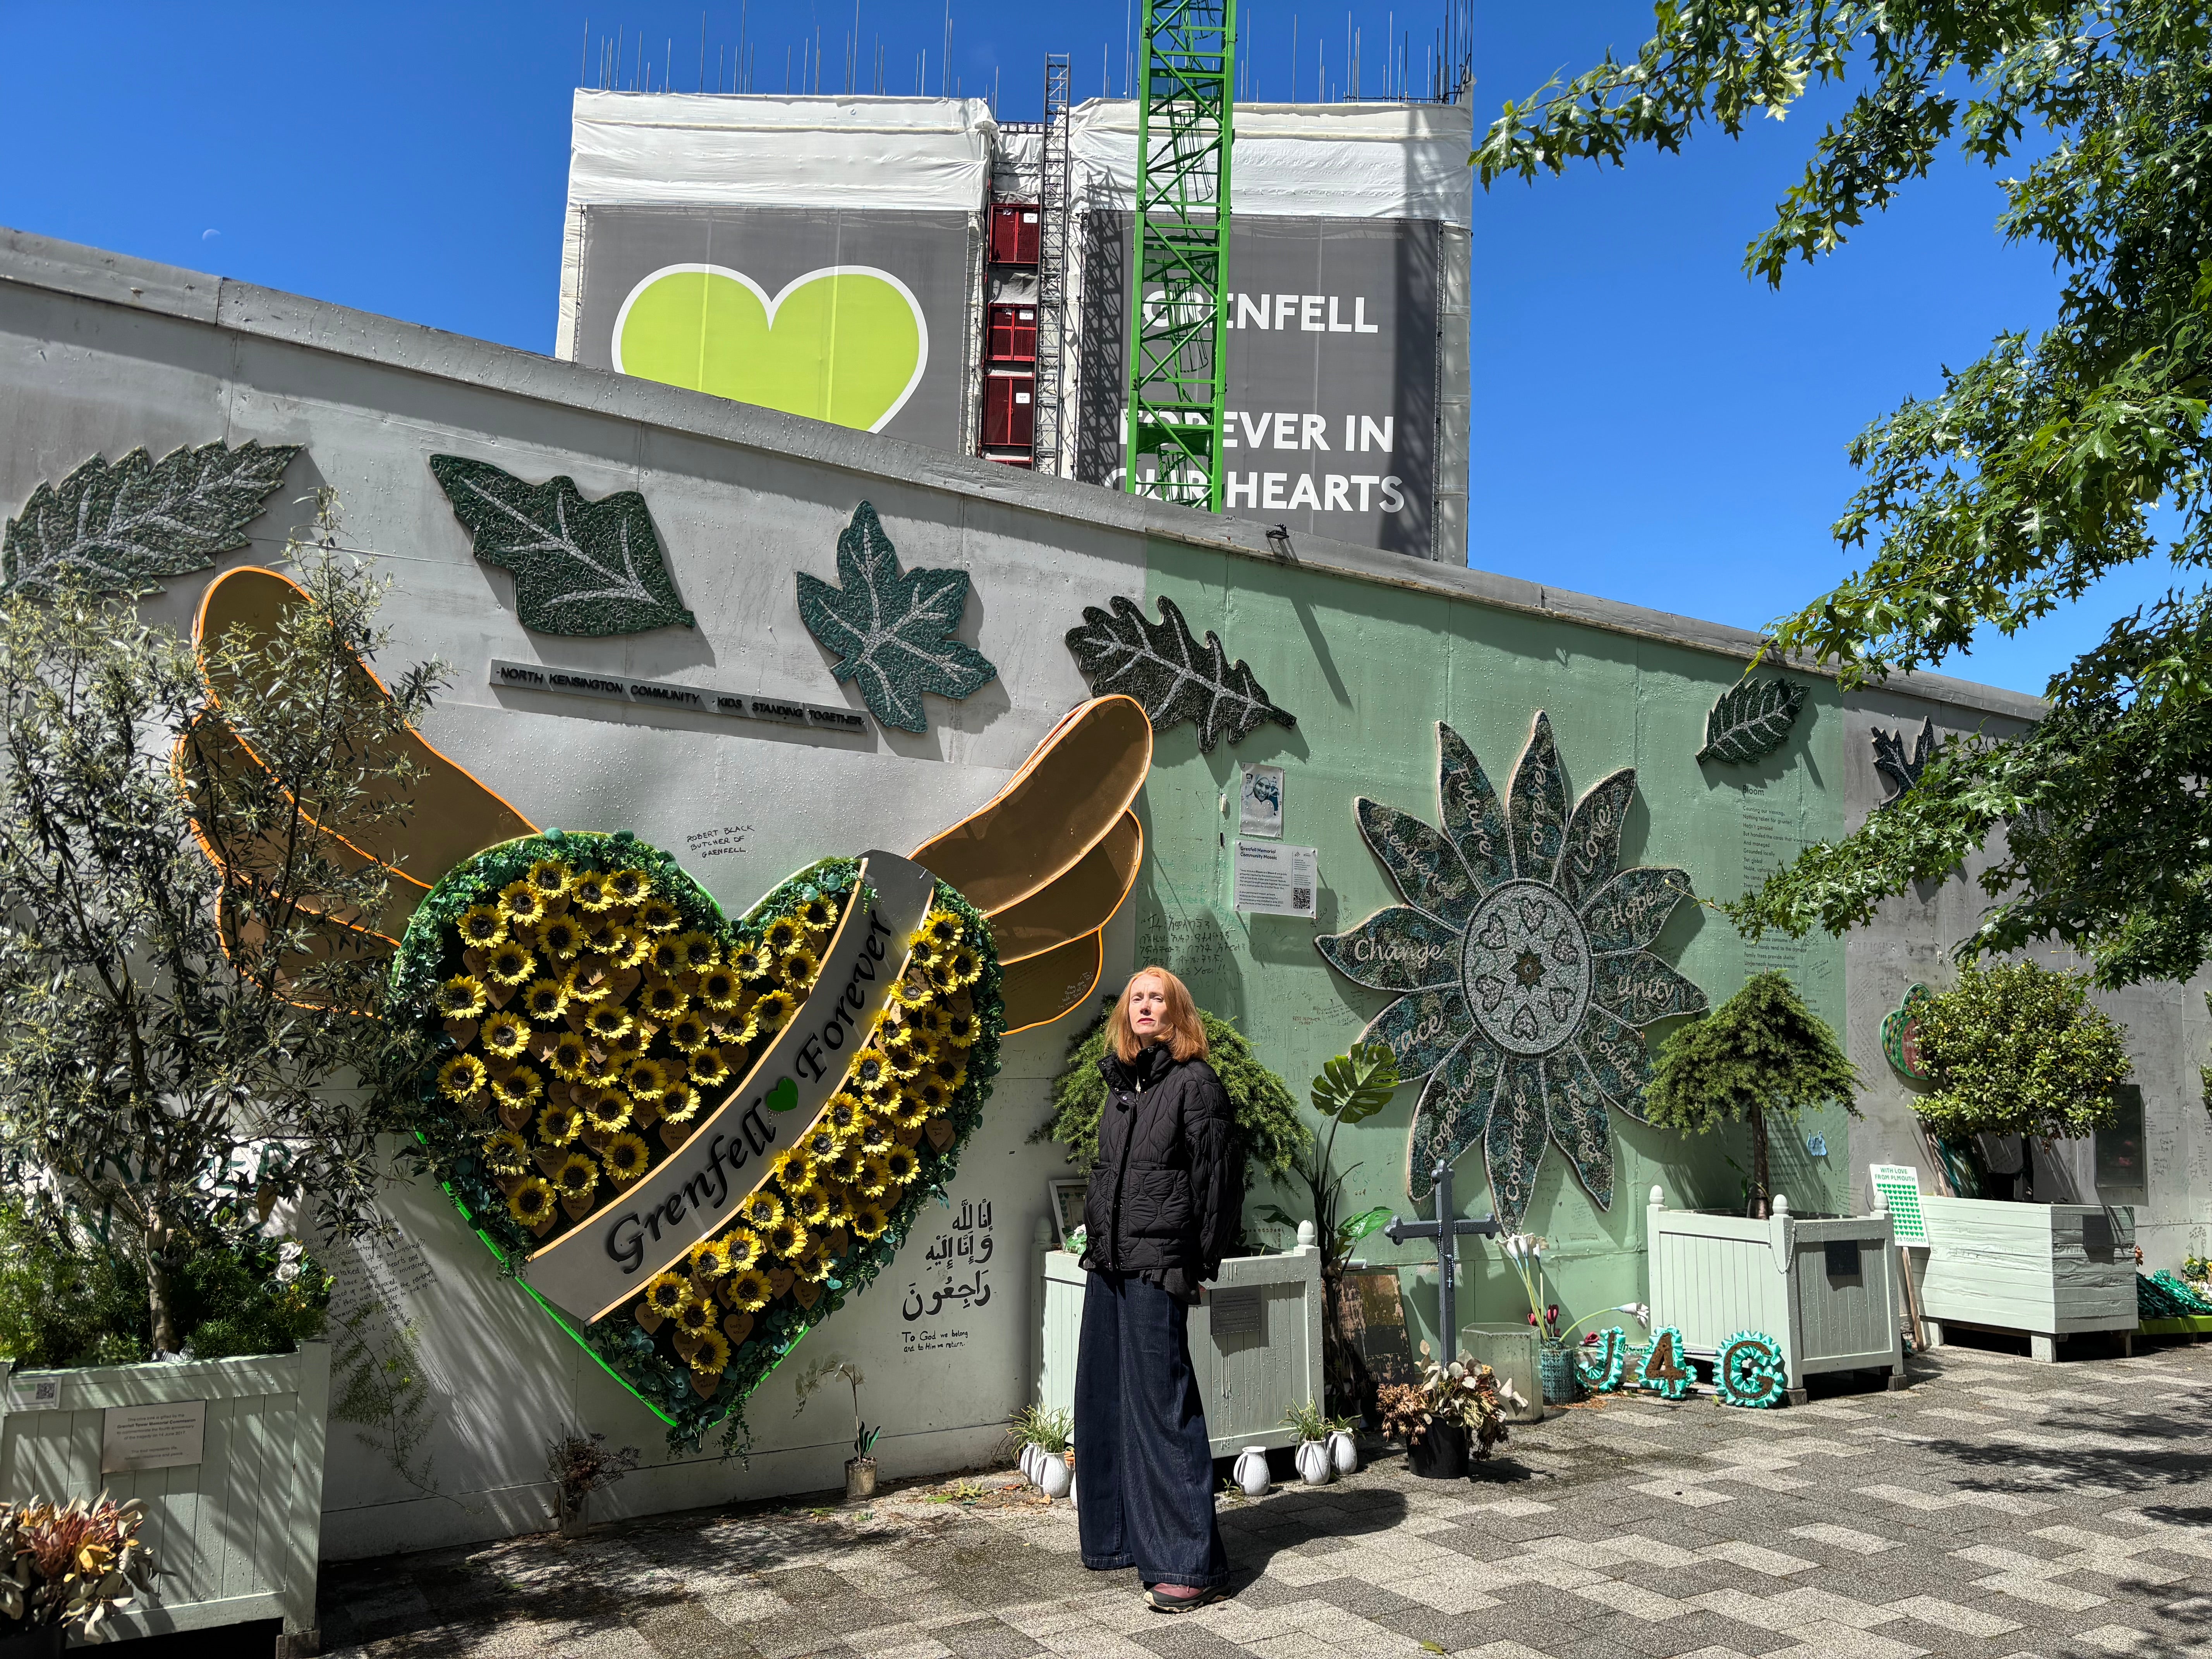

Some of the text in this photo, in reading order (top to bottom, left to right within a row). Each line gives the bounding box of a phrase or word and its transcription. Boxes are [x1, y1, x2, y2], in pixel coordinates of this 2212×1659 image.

[1346, 415, 1394, 452] IN
[1227, 471, 1405, 513] HEARTS
[501, 668, 862, 725] NORTH KENSINGTON COMMUNITY KIDS STANDING TOGETHER
[1743, 785, 1764, 795] Bloom
[1449, 762, 1494, 857] Future
[1527, 754, 1549, 861] Forever
[687, 825, 755, 842] ROBERT BLACK
[690, 838, 730, 851] BUTCHER
[702, 847, 746, 858] GRENFELL
[1611, 891, 1658, 929] Hope
[1354, 939, 1444, 970] Change
[795, 909, 892, 1083] Forever
[1617, 975, 1675, 1006] Unity
[1386, 1015, 1443, 1052] race
[1505, 1088, 1530, 1201] Courage
[606, 1097, 777, 1274] Grenfell
[304, 1233, 326, 1245] could
[386, 1256, 405, 1267] hearts
[409, 1254, 419, 1262] and
[328, 1302, 340, 1311] will
[343, 1298, 357, 1307] they
[376, 1286, 398, 1298] between
[330, 1290, 347, 1301] anged
[410, 1286, 420, 1295] pick
[356, 1324, 377, 1336] have
[902, 1331, 915, 1343] To
[919, 1331, 936, 1341] God
[951, 1329, 968, 1338] belong
[903, 1345, 915, 1353] and
